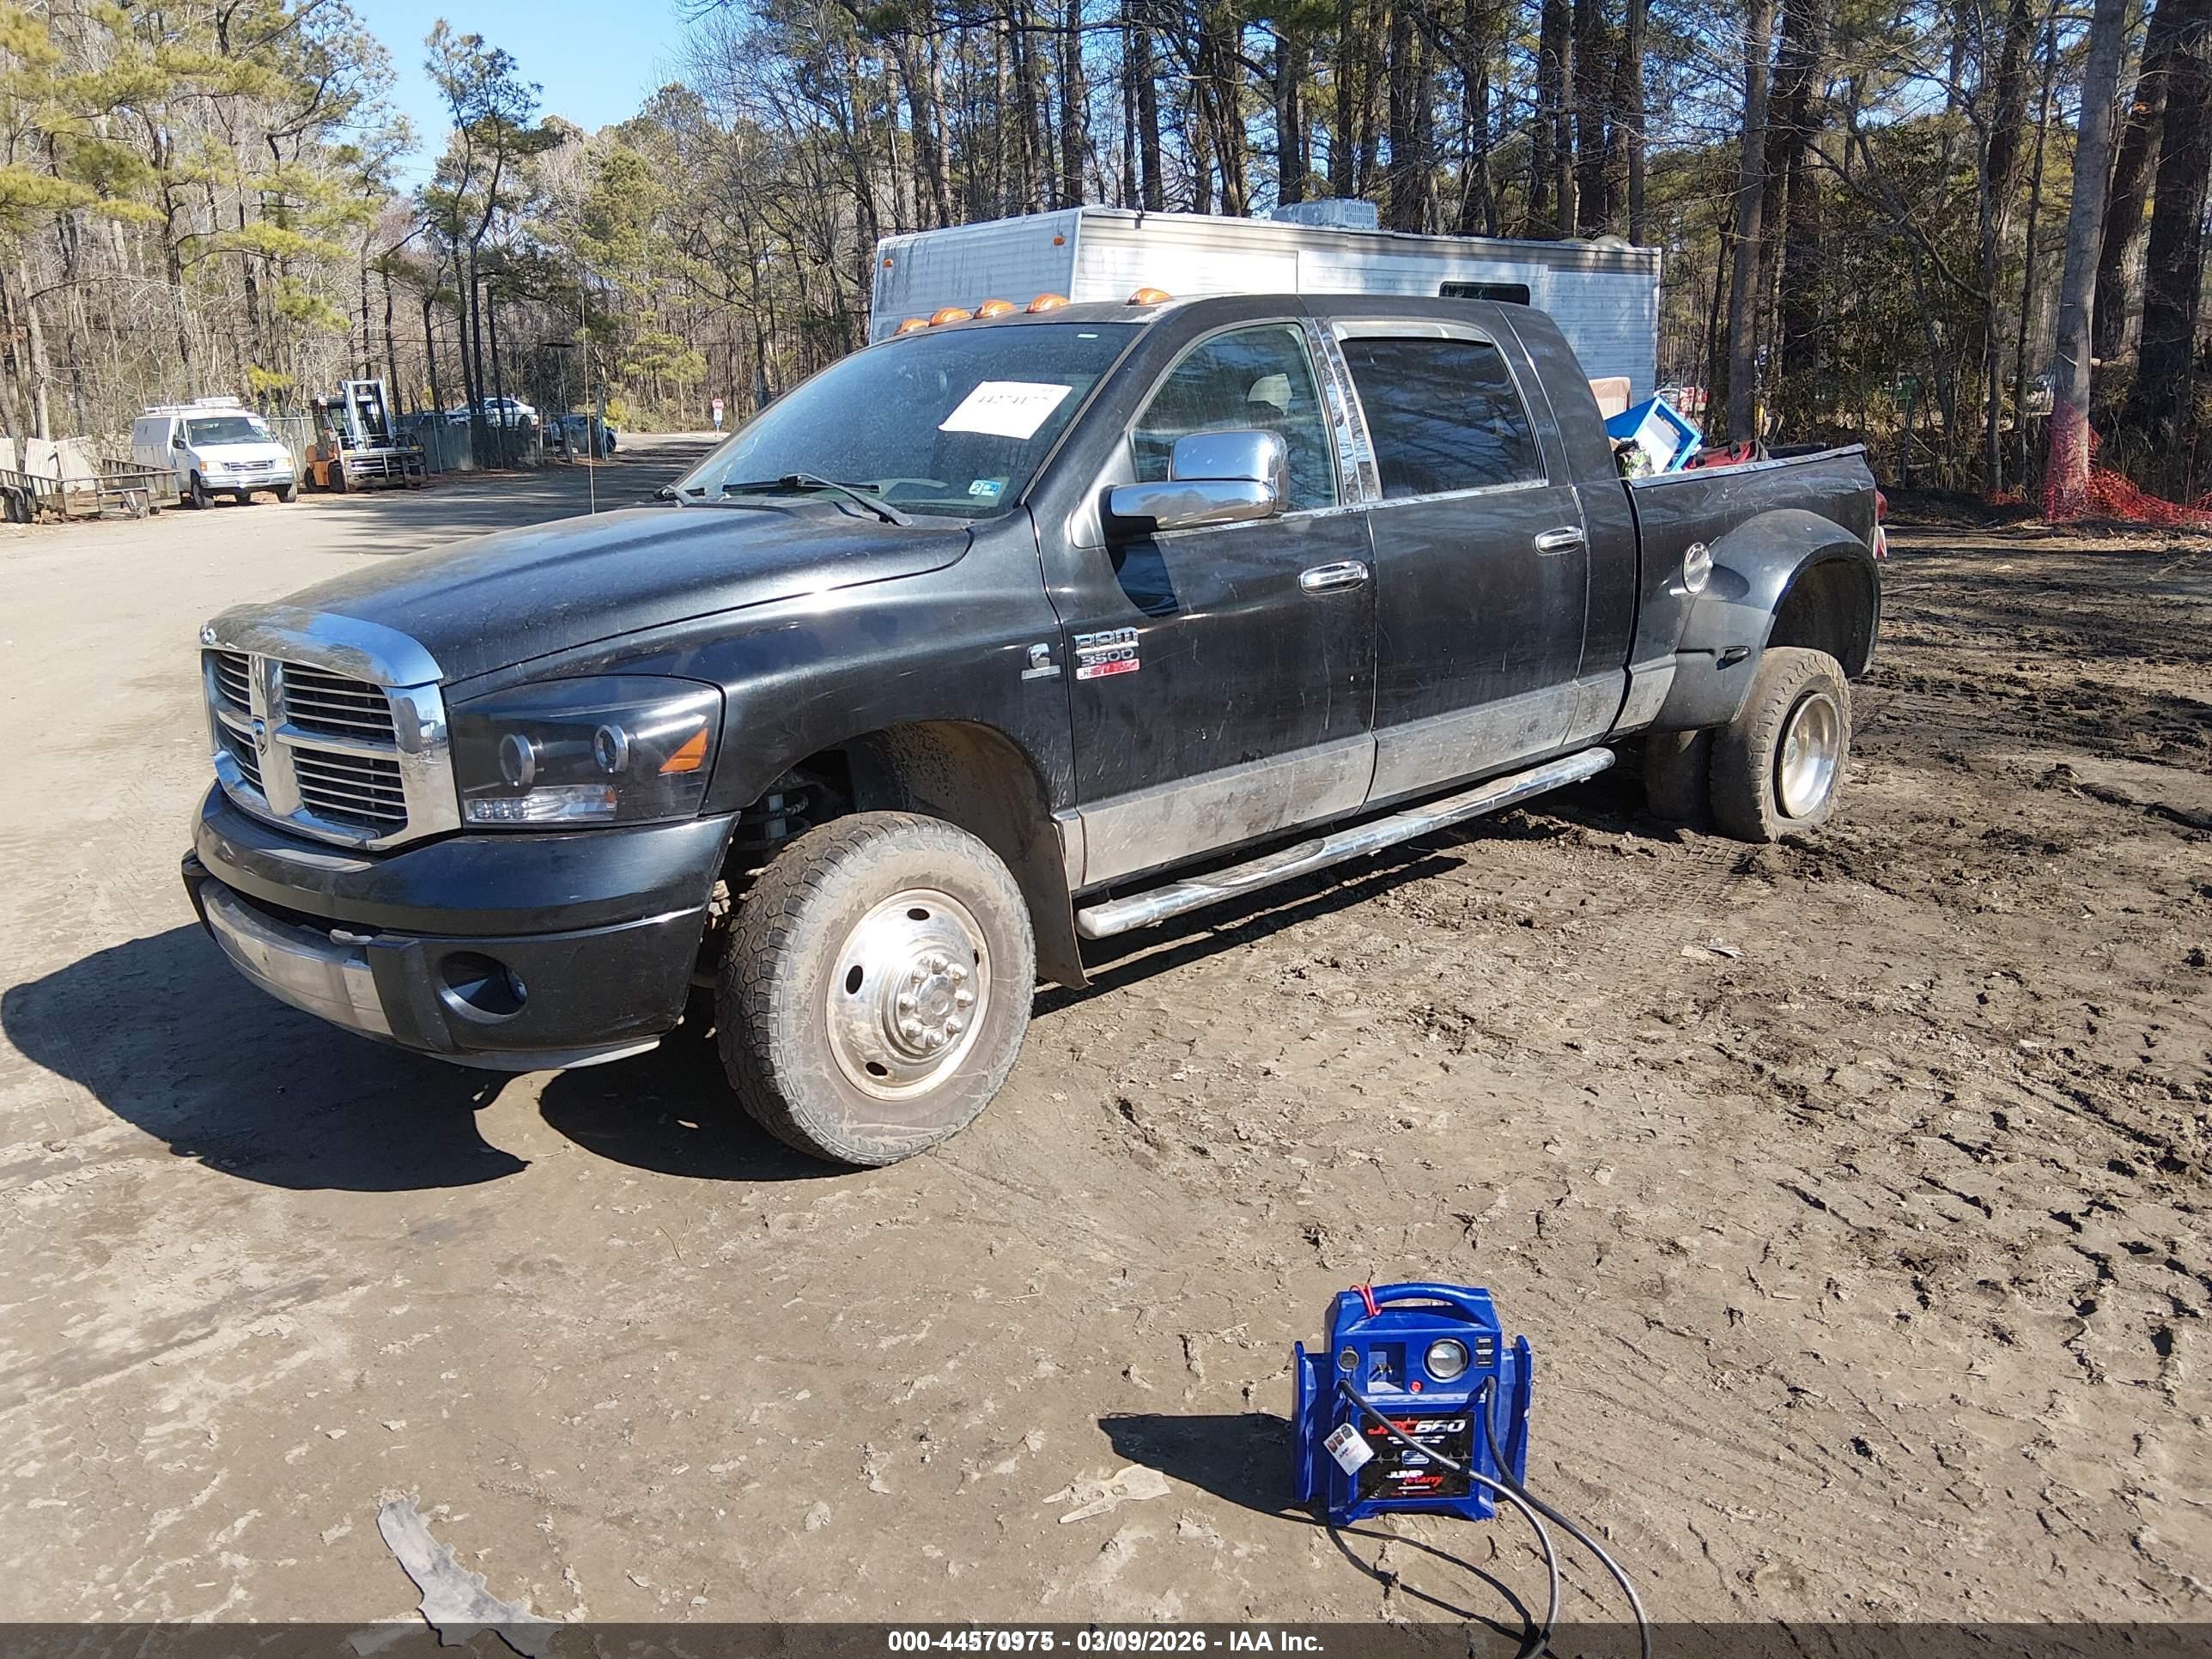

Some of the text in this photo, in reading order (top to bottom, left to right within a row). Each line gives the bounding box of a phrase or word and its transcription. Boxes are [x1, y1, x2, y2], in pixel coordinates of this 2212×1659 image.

[1072, 627, 1139, 653] RAM
[1080, 648, 1135, 667] 3500
[1386, 1470, 1424, 1479] JUMP
